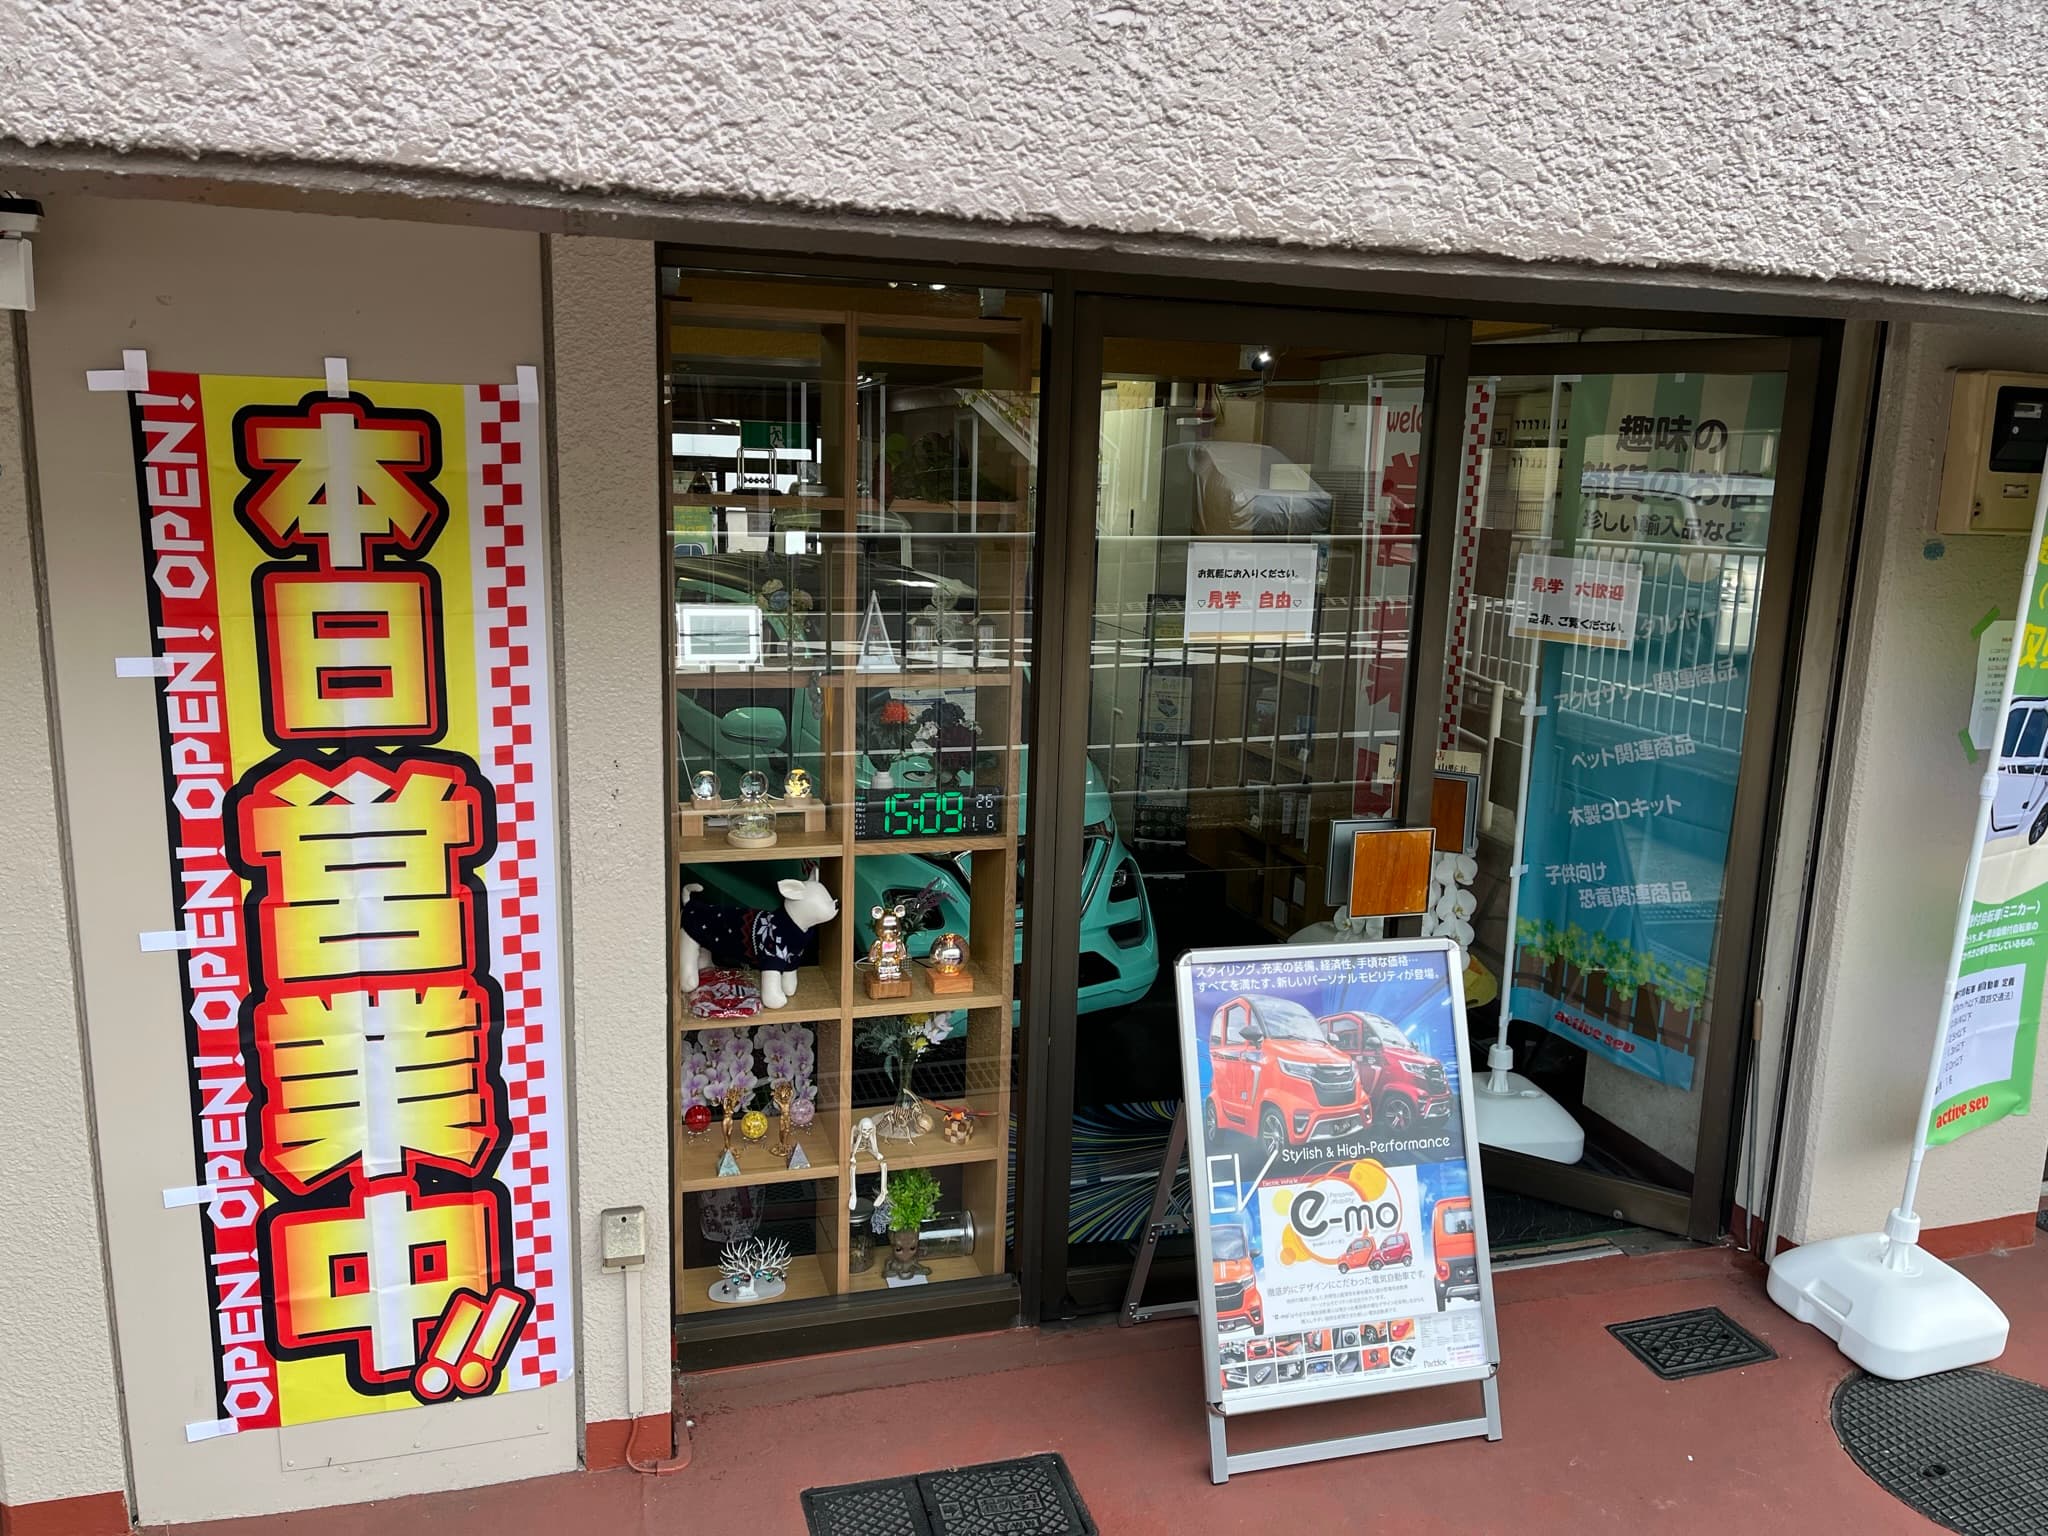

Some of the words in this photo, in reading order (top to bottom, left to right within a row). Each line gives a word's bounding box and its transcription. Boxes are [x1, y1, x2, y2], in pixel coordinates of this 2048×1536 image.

[1616, 415, 1729, 454] 趣味の
[135, 392, 210, 599] OPEN!
[1582, 461, 1764, 510] 雑貨のお店
[1582, 509, 1746, 543] 珍しい輸入品など
[1197, 568, 1299, 579] お気軽にお入りください。
[1531, 576, 1564, 593] 見学
[1575, 582, 1625, 600] 大歓迎
[1207, 590, 1242, 608] 見学
[1259, 590, 1292, 608] 自由
[1554, 659, 1738, 711] アクセサリー関連商品
[157, 625, 226, 820] OPEN!
[1571, 733, 1697, 769] ペット関連商品
[883, 791, 964, 836] 15:09
[976, 793, 995, 809] 26
[1568, 795, 1682, 827] 木製3Dキット
[1545, 862, 1608, 886] 子供向け
[1578, 881, 1693, 909] 恐竜関連商品
[176, 845, 241, 1031] OPEN!
[1936, 1103, 1967, 1128] active
[1969, 1096, 1989, 1113] sev
[193, 1052, 260, 1229] OPEN!
[1282, 1146, 1323, 1164] Stylish
[1326, 1147, 1335, 1158] &
[1337, 1136, 1451, 1159] High-Performance
[1290, 1190, 1399, 1237] e-mo
[210, 1247, 273, 1418] OPEN!
